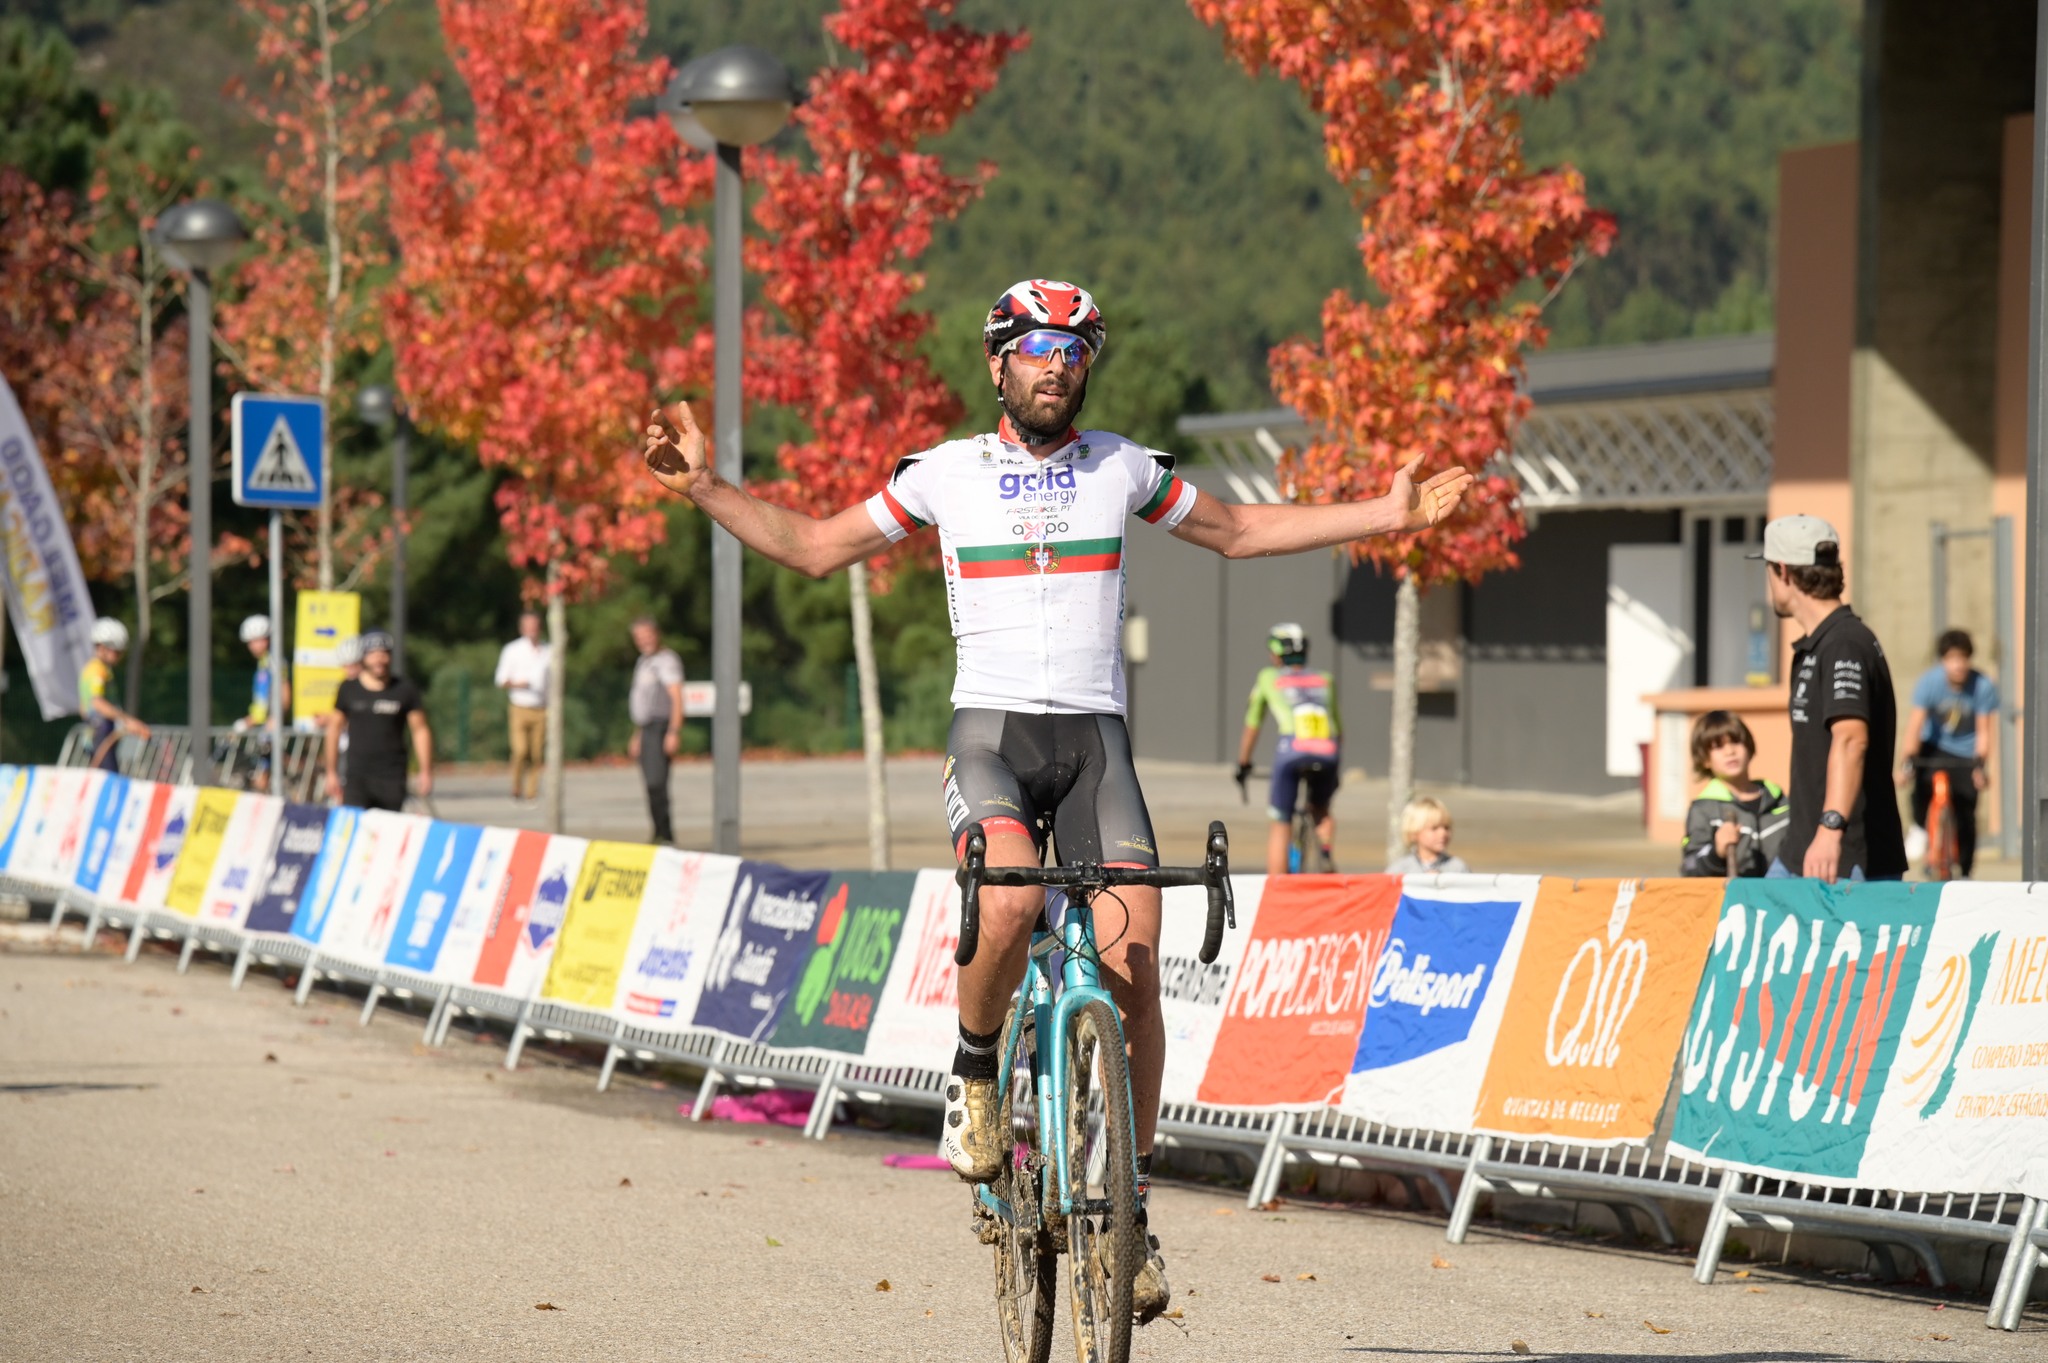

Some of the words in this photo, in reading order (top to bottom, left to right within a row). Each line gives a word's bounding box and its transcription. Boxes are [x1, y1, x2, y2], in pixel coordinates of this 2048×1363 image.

[999, 463, 1076, 500] gold
[1023, 490, 1077, 504] energy
[1228, 926, 1390, 1019] POPPDESIGN
[1373, 952, 1487, 1017] Polisport
[1991, 935, 2048, 1006] MEL
[1682, 903, 1912, 1126] CISION
[2022, 1041, 2048, 1067] DESP
[1503, 1097, 1551, 1119] QUINTAS
[1551, 1099, 1567, 1120] DE
